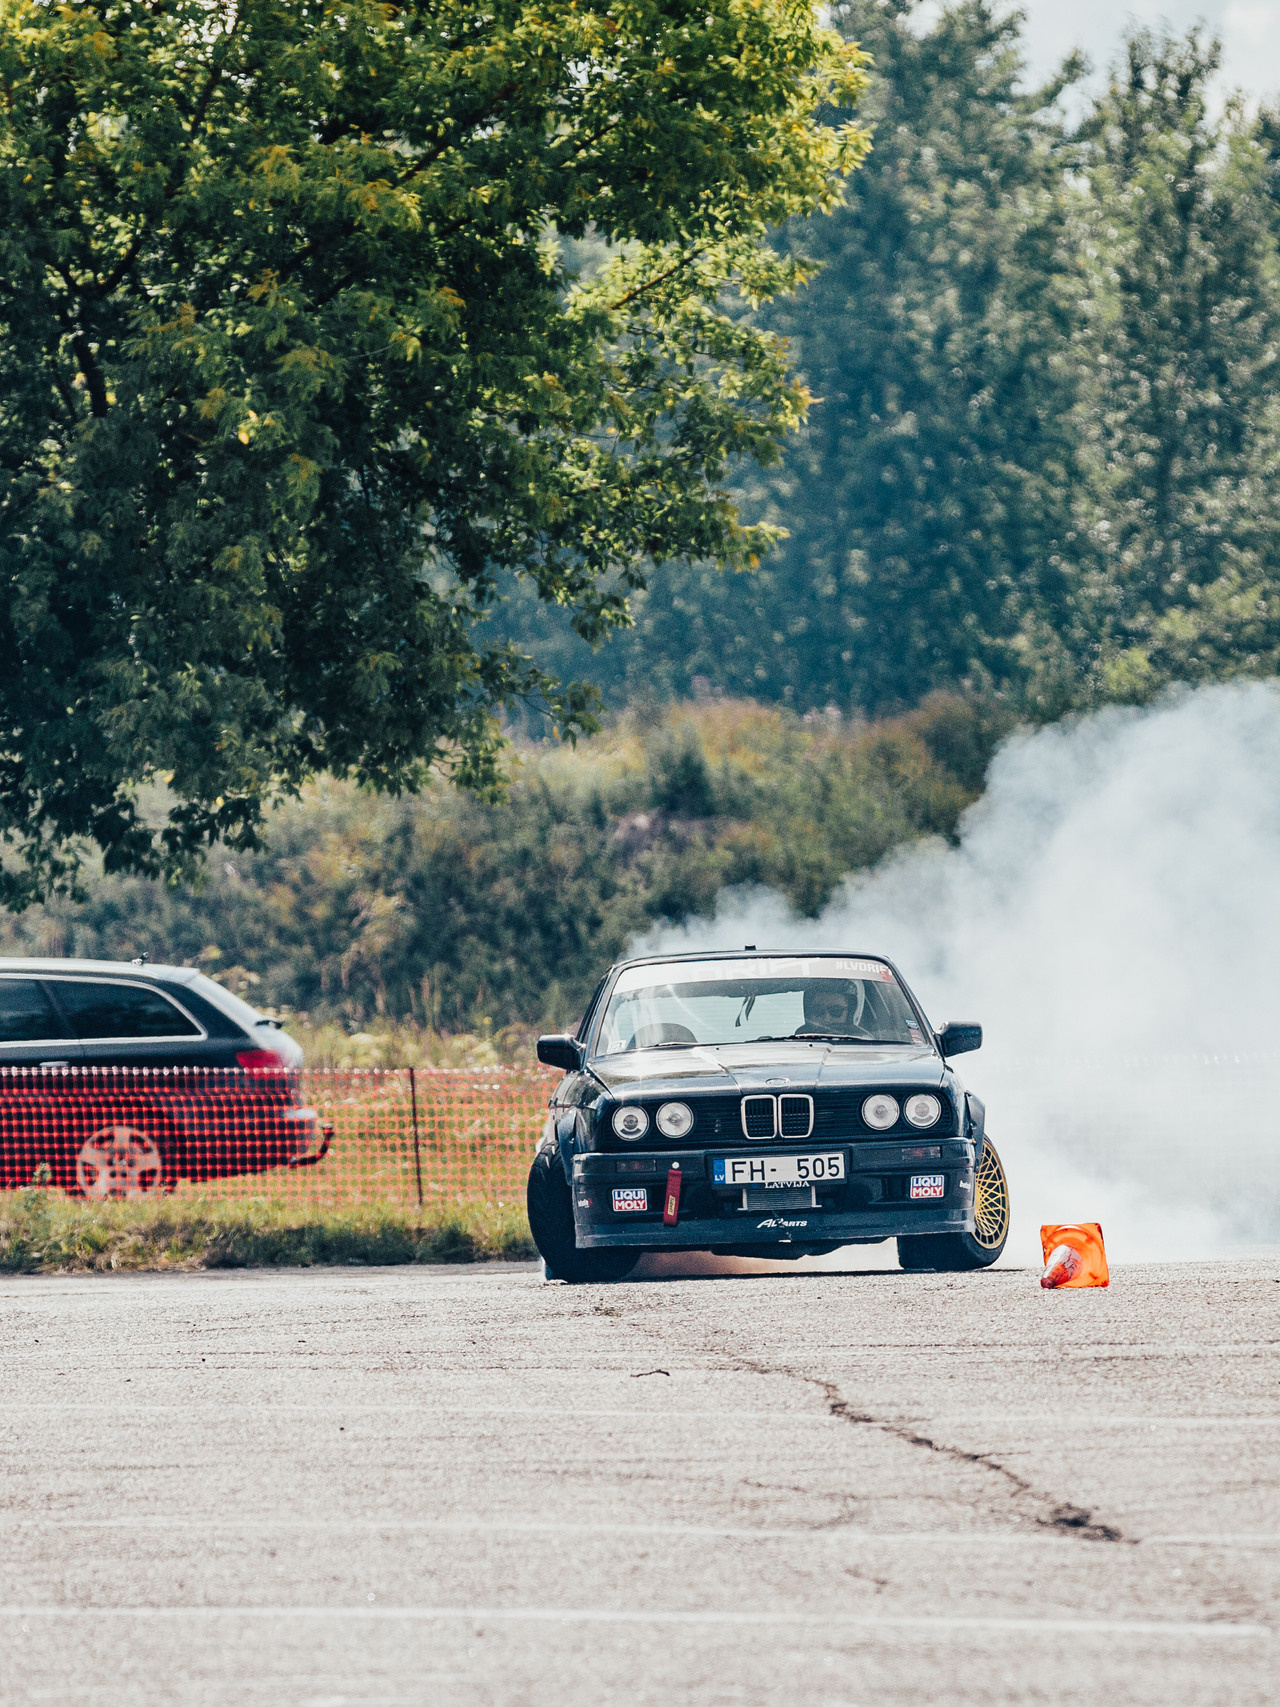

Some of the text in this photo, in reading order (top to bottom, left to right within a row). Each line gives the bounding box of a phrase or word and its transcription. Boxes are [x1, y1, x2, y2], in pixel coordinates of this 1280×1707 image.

[797, 1157, 840, 1179] 505
[764, 1181, 810, 1189] LATVIJA
[913, 1177, 942, 1187] LIQUI
[614, 1190, 645, 1200] LIQUI
[912, 1187, 942, 1197] MOLY
[615, 1200, 645, 1210] MOLY
